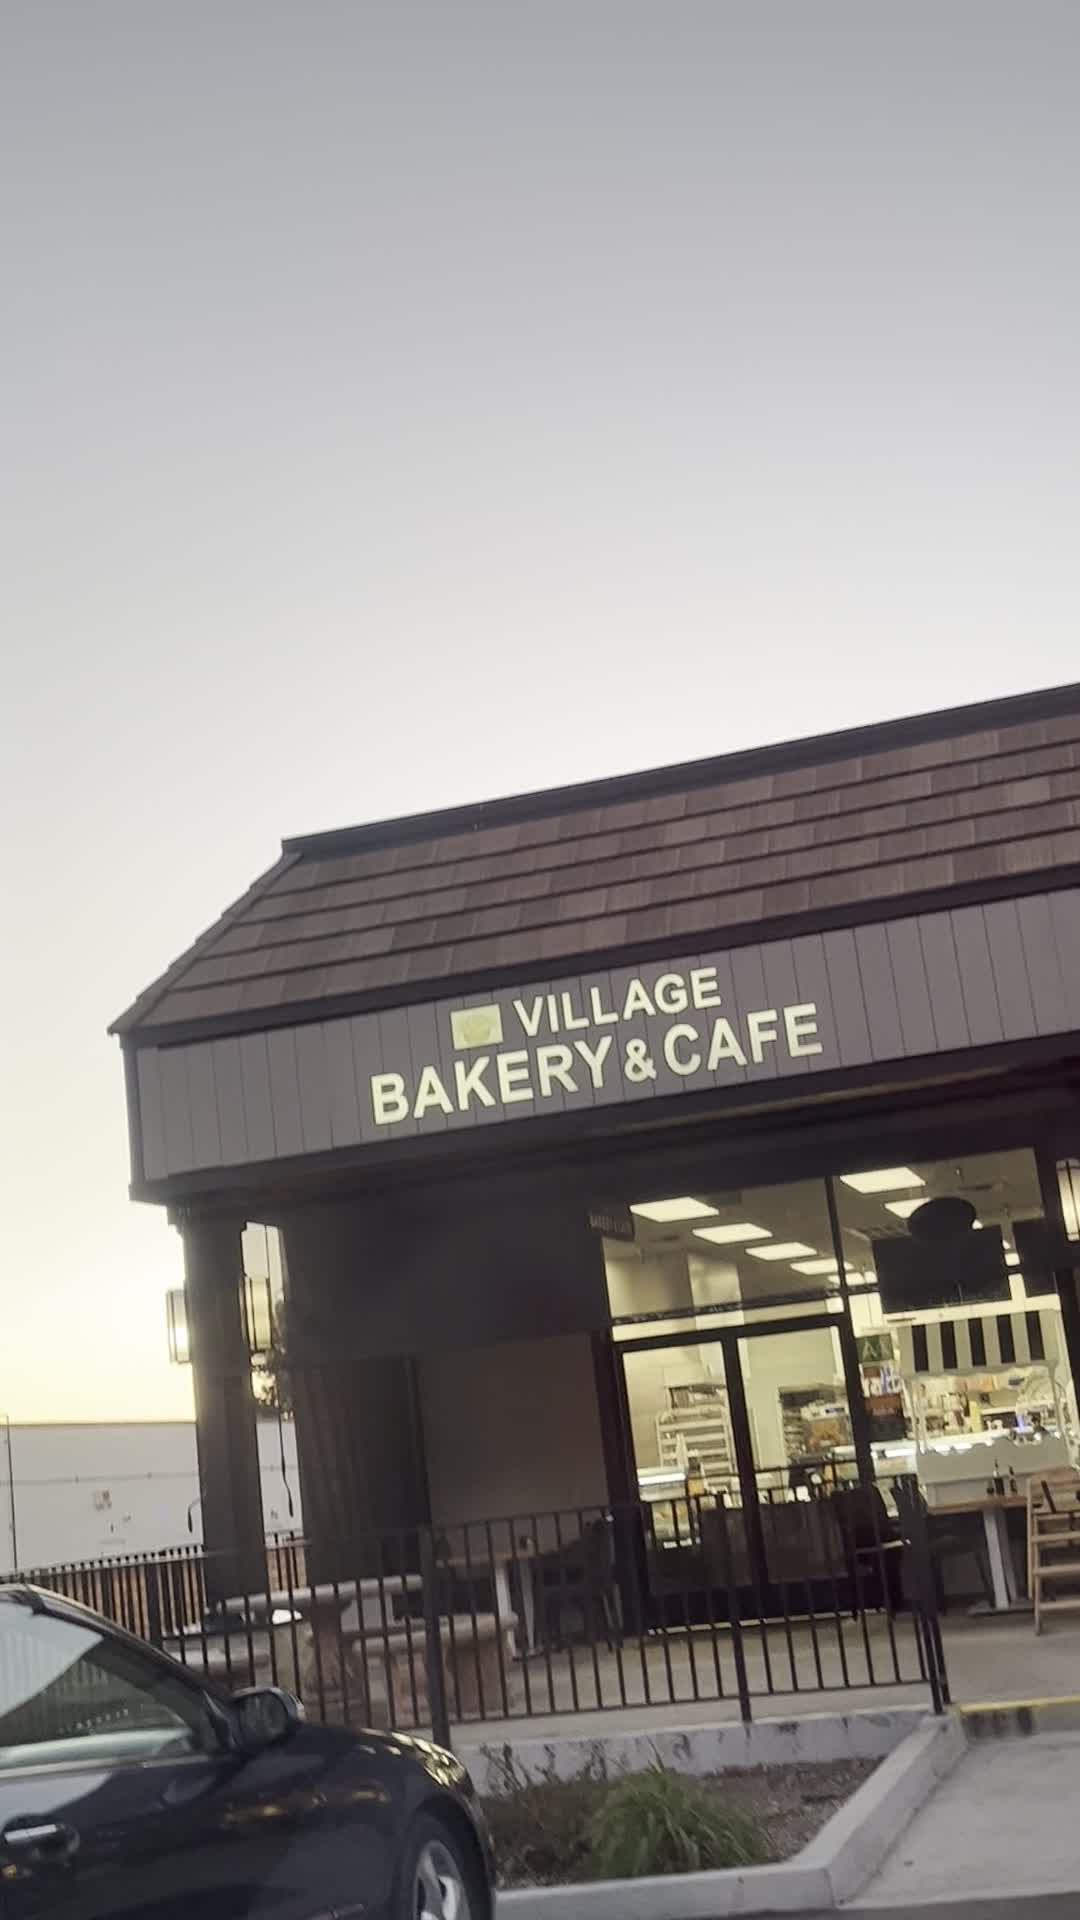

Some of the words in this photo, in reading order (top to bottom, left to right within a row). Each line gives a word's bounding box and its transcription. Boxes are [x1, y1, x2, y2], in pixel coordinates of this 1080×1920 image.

[513, 967, 722, 1037] VILLAGE
[371, 1035, 613, 1125] BAKERY
[624, 1038, 657, 1082] &
[664, 1002, 823, 1075] CAFE
